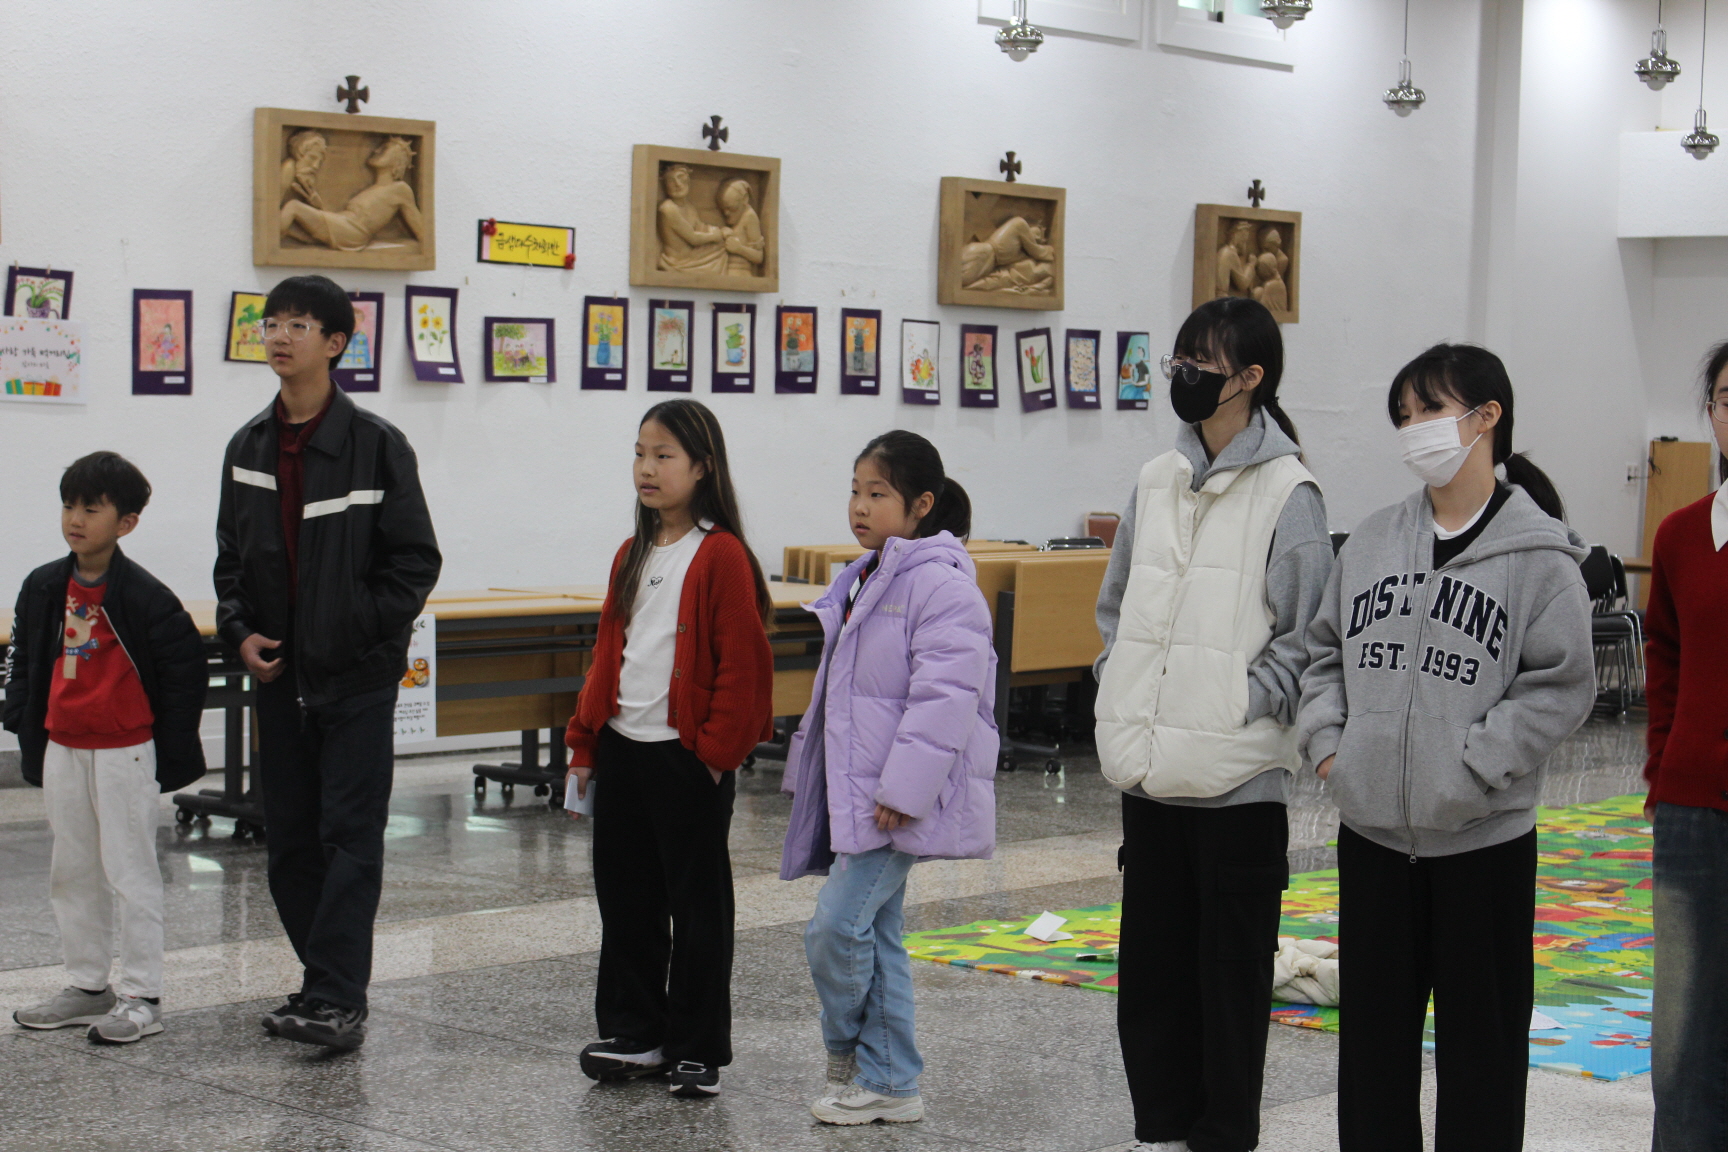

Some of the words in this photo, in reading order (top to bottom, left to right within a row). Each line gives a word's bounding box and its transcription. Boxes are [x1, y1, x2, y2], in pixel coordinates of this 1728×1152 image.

[1345, 572, 1426, 640] DIST
[1430, 574, 1508, 662] NINE
[1358, 641, 1407, 671] EST.
[1420, 645, 1481, 686] 1993
